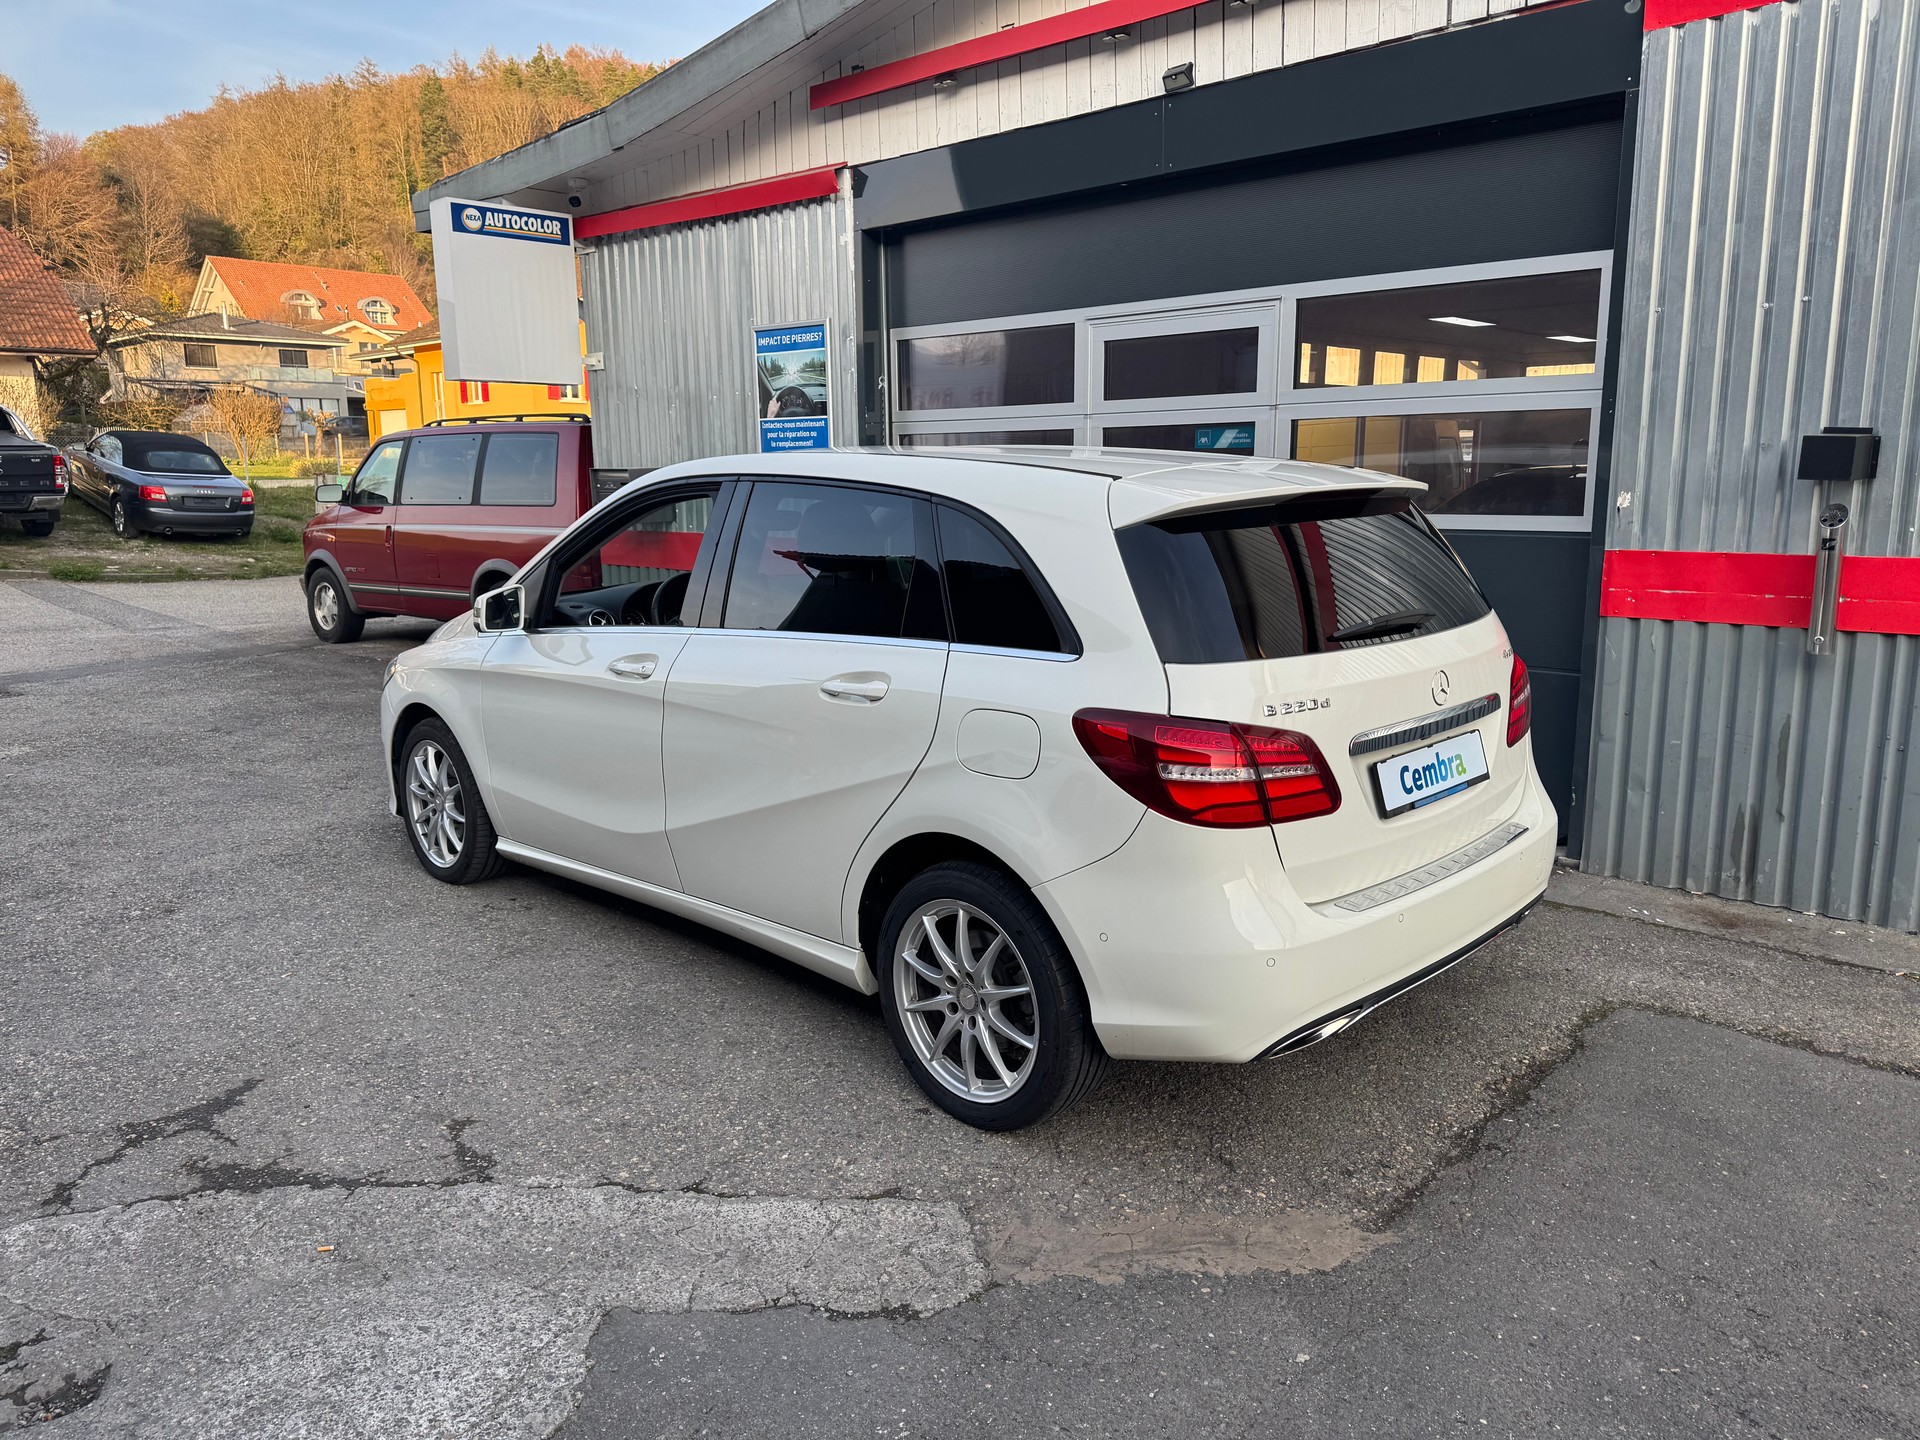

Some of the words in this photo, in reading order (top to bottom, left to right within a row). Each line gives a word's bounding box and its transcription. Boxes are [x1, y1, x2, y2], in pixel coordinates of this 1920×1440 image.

[465, 213, 481, 222] NEXA
[485, 211, 561, 235] AUTOCOLOR
[758, 336, 781, 347] IMPACT
[782, 335, 791, 345] DE
[791, 331, 823, 343] PIERRES?
[796, 420, 825, 428] maintenant
[767, 431, 778, 439] pour
[779, 430, 784, 438] la
[784, 430, 810, 439] réparation
[1262, 704, 1277, 717] B
[1399, 751, 1467, 796] Cembra
